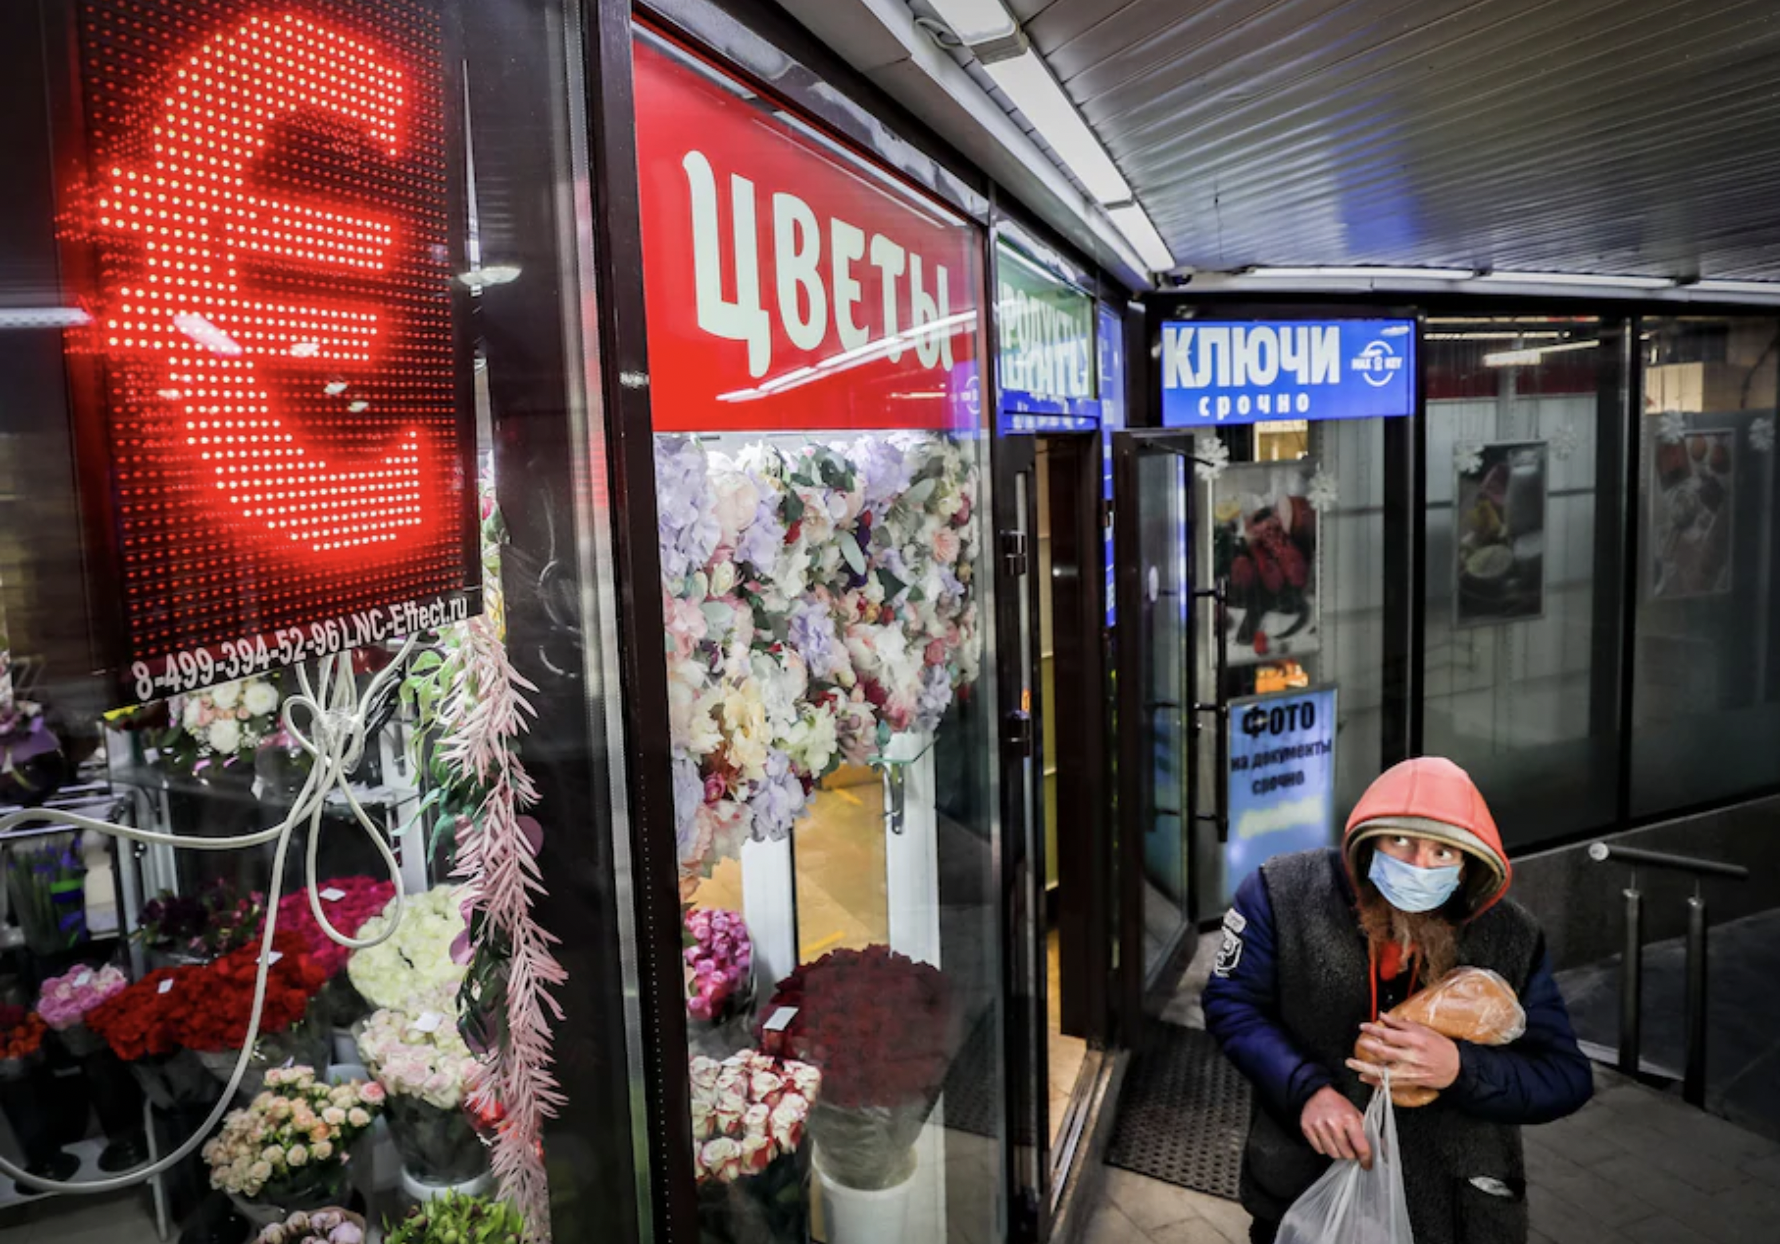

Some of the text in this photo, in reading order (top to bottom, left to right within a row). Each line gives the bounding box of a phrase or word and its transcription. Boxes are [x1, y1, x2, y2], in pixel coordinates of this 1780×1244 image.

[682, 149, 953, 378] ЦВЕТЫ
[1163, 326, 1340, 389] КЛЮЧИ
[1199, 392, 1310, 421] срочно
[133, 618, 342, 700] 8-499-394-52-96
[1242, 702, 1315, 738] ФОТО
